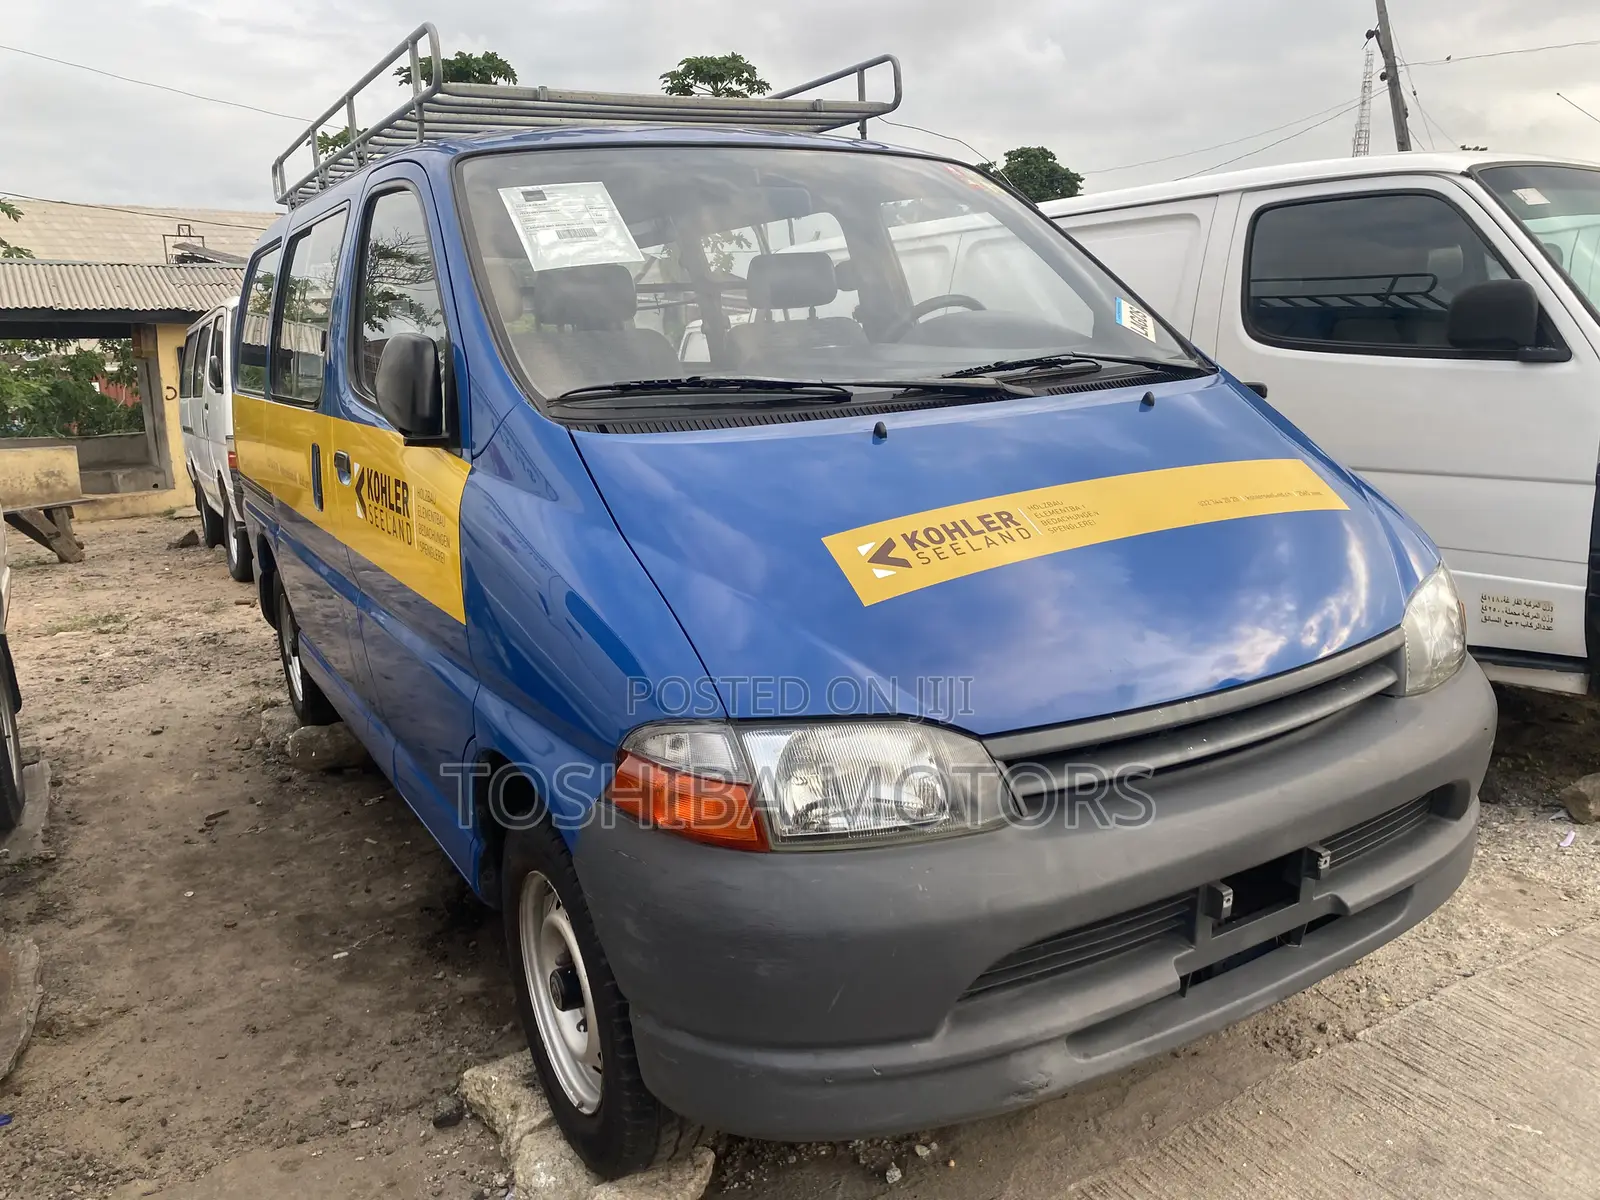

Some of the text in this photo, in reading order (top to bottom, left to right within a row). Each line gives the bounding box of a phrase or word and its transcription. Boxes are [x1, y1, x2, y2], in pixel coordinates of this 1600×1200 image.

[366, 467, 410, 518] KOHLER
[1026, 499, 1064, 512] HOLZBAU
[367, 506, 412, 546] SEELAND
[417, 504, 446, 528] ELEMENTBAU
[900, 510, 1022, 552] KOHLER
[417, 522, 451, 549] BEDACHUNGEN
[915, 527, 1032, 566] SEELAND
[418, 541, 446, 565] SPENGLEREI
